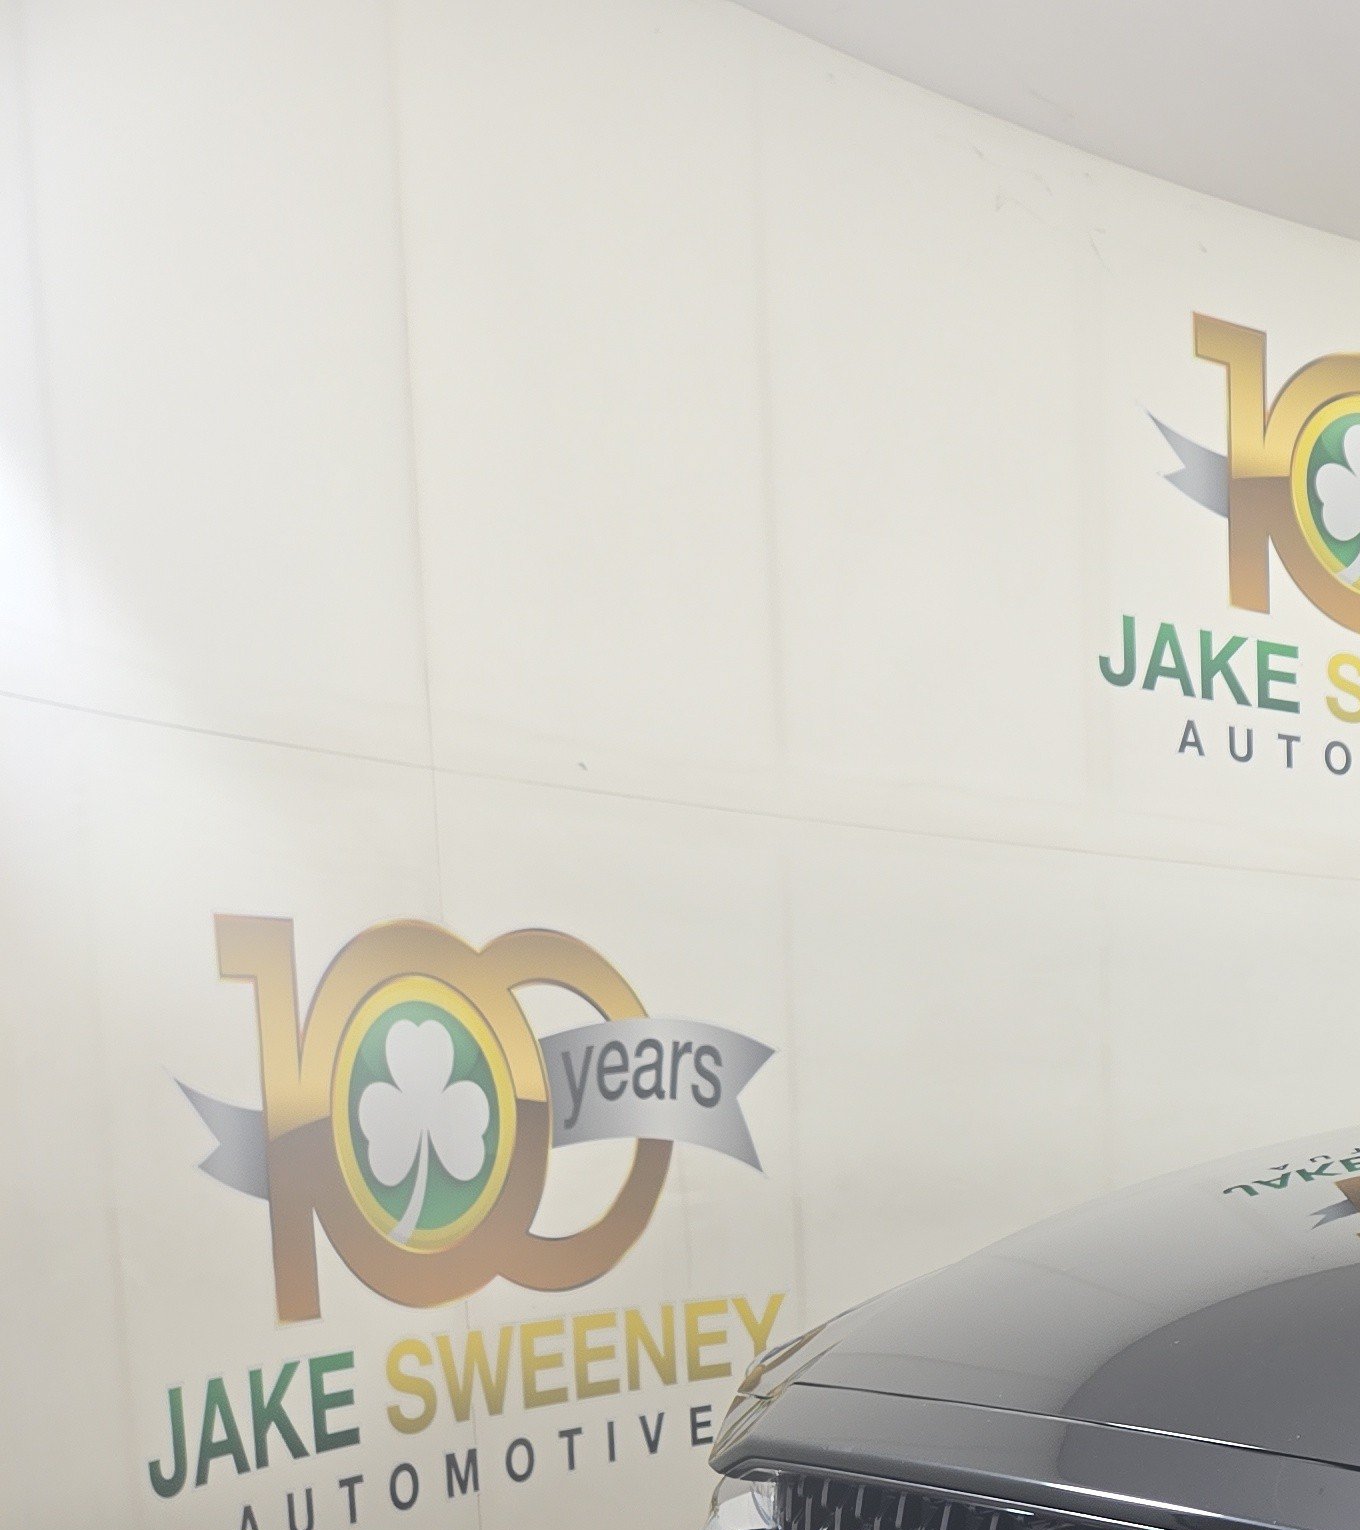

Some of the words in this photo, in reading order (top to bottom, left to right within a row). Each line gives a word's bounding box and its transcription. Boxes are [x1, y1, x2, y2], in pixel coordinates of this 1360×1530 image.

[1099, 614, 1301, 714] JAKE
[560, 1036, 723, 1131] years
[148, 1350, 361, 1499] JAKE
[385, 1291, 787, 1436] SWEENEY
